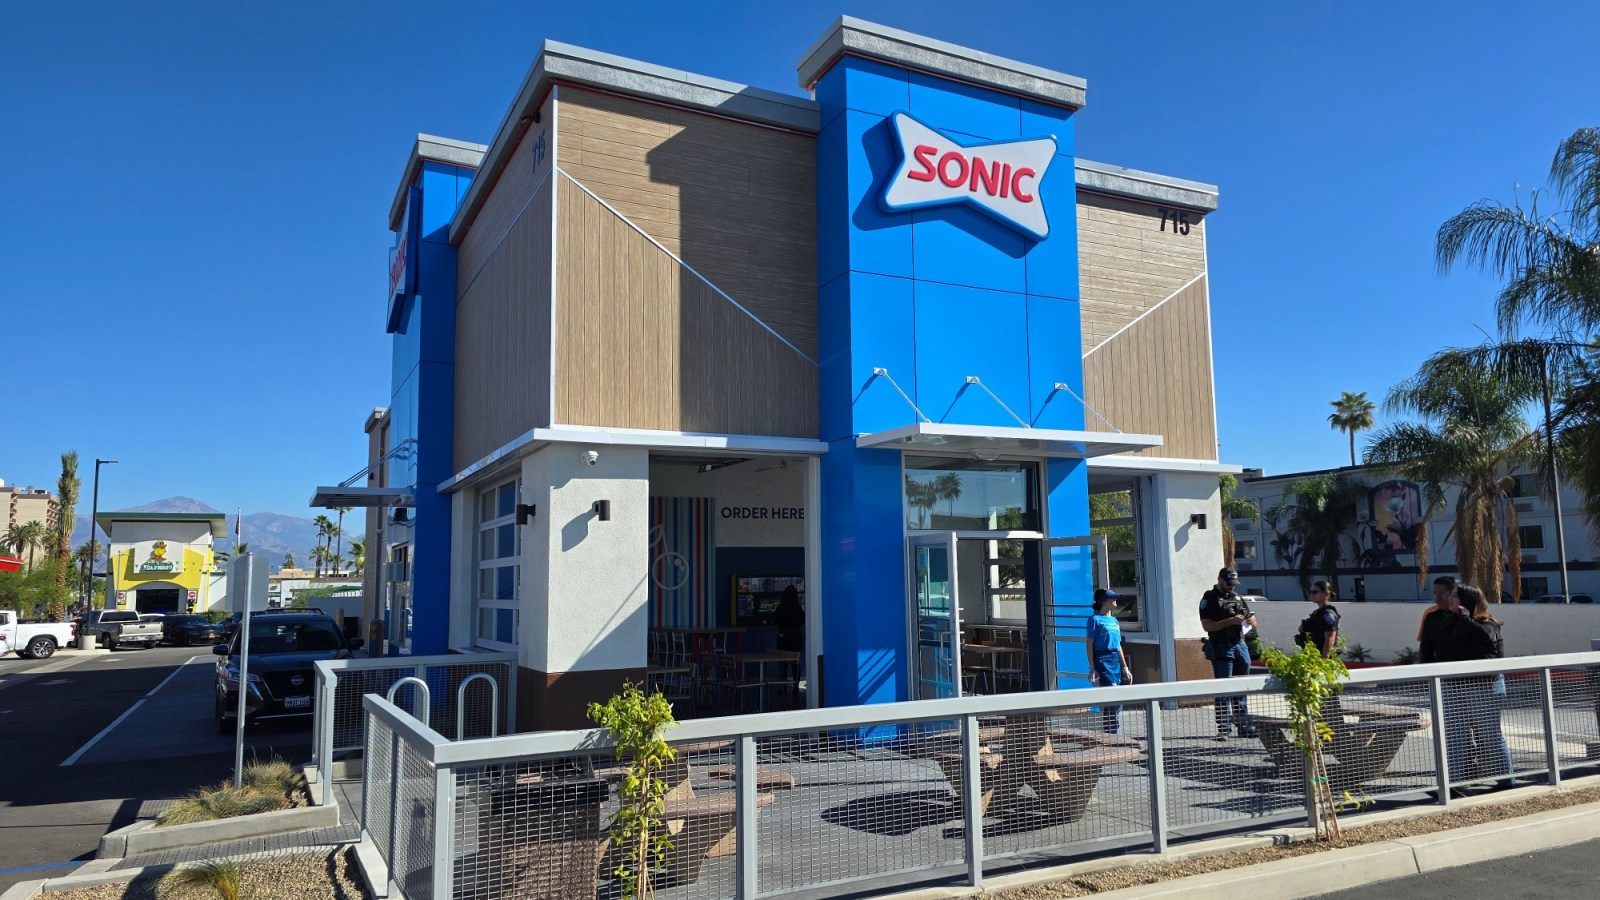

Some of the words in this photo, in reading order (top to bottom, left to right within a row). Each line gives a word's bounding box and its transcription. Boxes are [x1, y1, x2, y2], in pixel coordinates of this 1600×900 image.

[532, 128, 546, 174] 715
[907, 144, 1036, 203] SONIC
[1157, 207, 1190, 236] 715
[721, 507, 768, 519] ORDER
[771, 507, 804, 520] HERE
